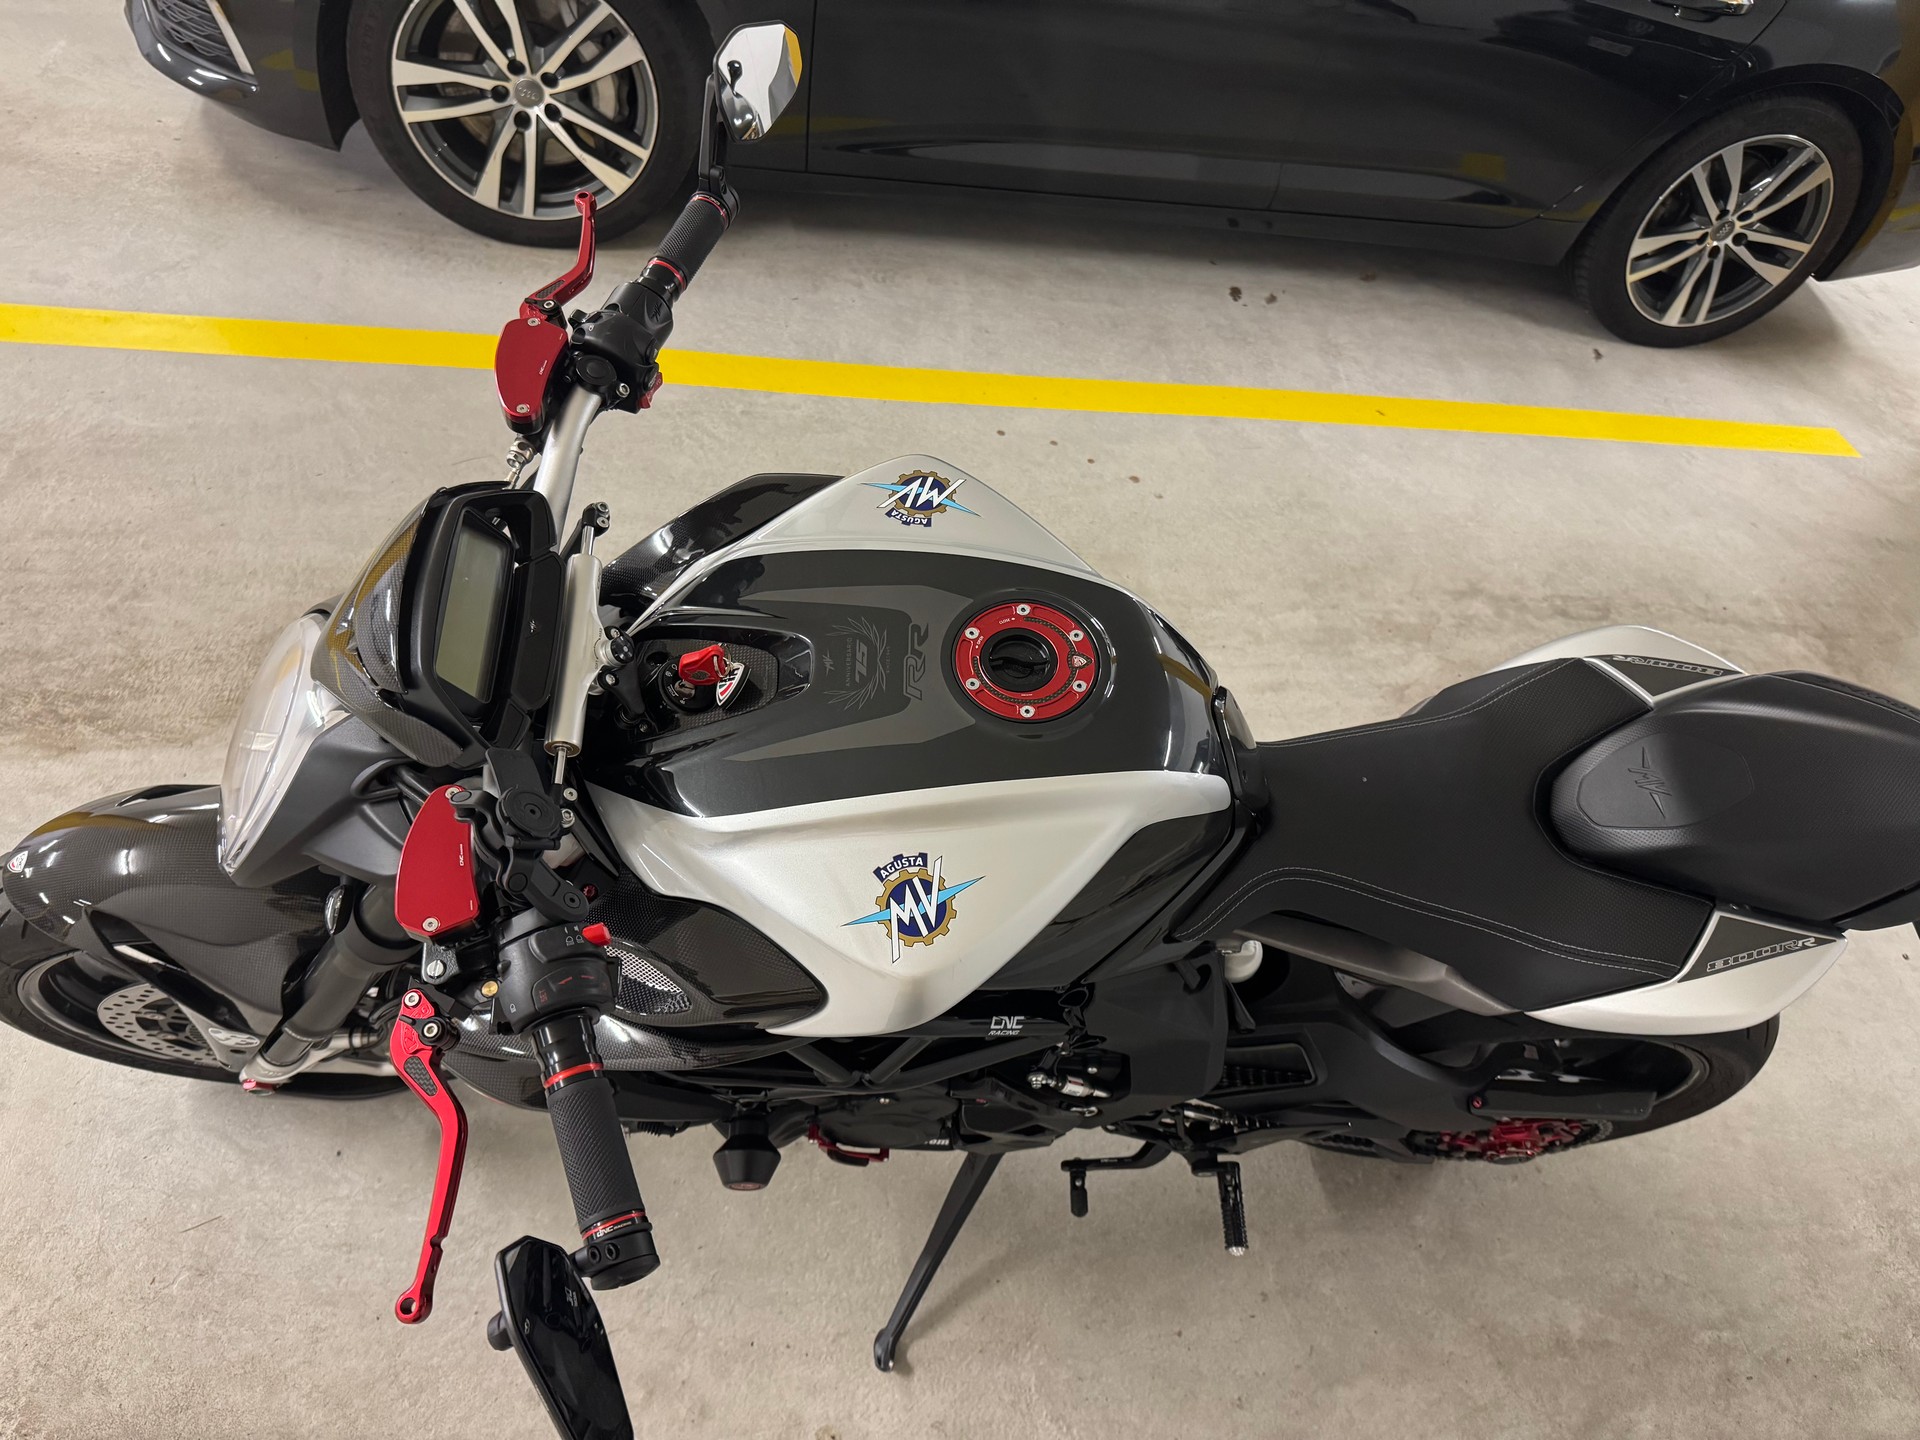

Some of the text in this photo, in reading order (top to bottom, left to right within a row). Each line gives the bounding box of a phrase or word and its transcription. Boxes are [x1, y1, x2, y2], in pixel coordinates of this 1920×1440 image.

[891, 509, 928, 525] AGUSTA
[855, 639, 868, 684] 75
[879, 857, 924, 879] AGUSTA
[891, 855, 943, 964] MV
[990, 1015, 1025, 1029] CNC
